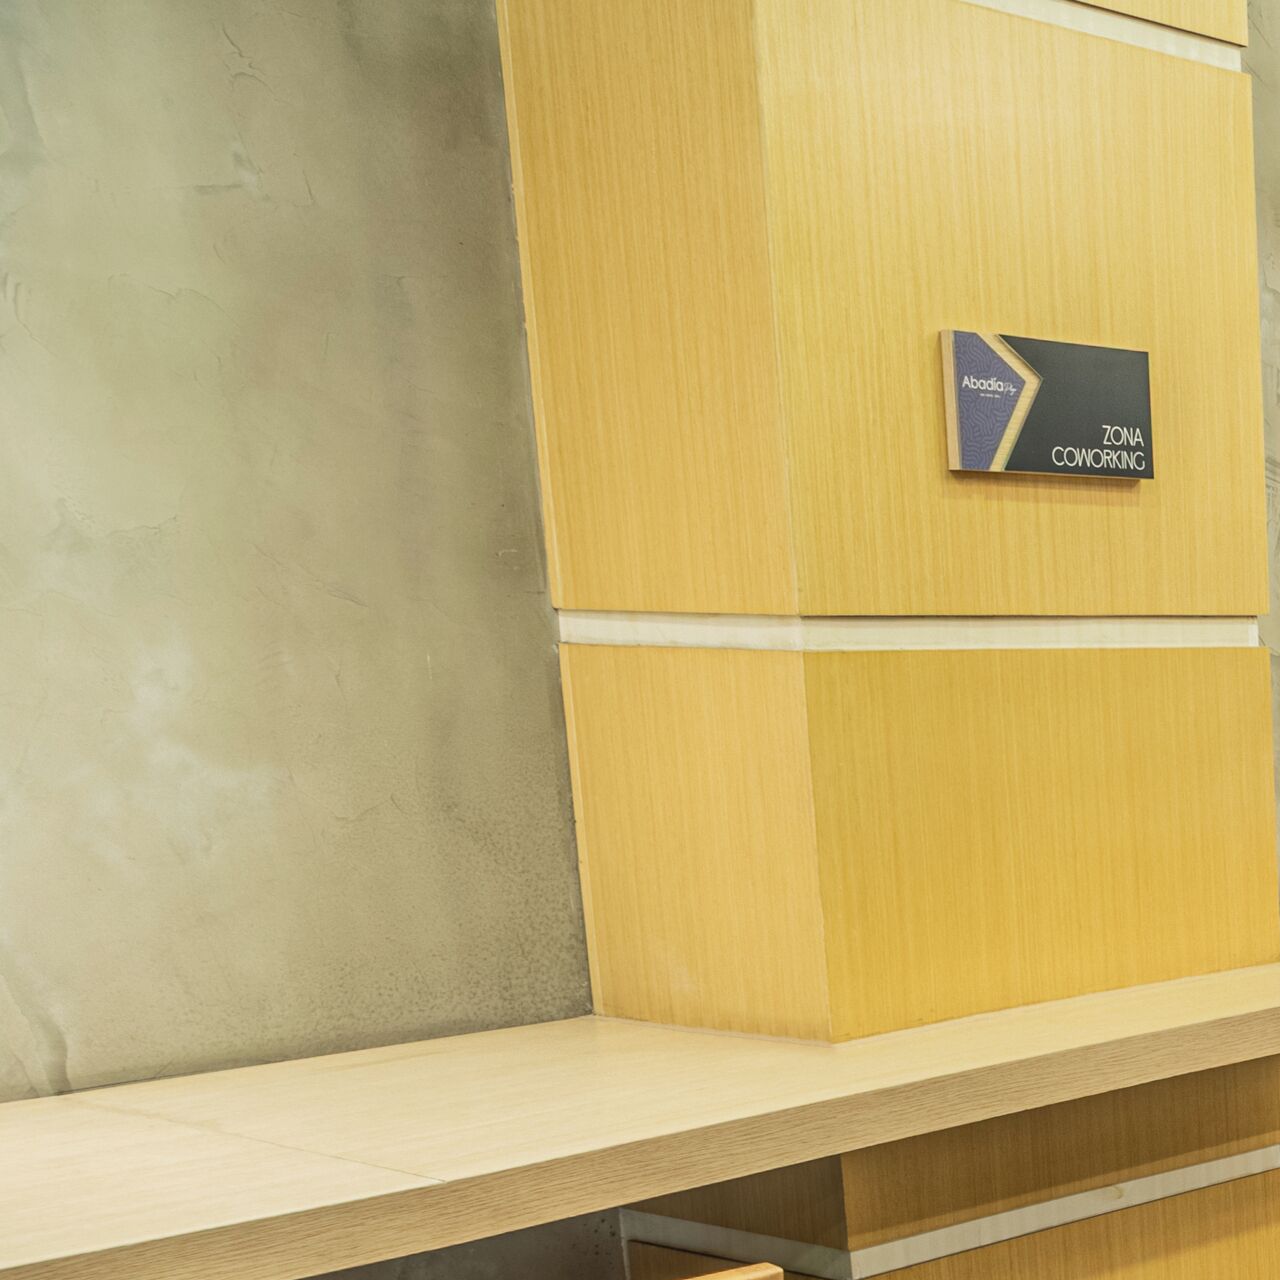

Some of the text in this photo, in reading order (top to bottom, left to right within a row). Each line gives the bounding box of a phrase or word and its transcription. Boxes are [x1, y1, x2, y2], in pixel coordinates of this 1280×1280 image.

[962, 375, 1004, 391] Abadía
[1102, 424, 1144, 447] ZONA
[1052, 446, 1145, 470] COWORKING
